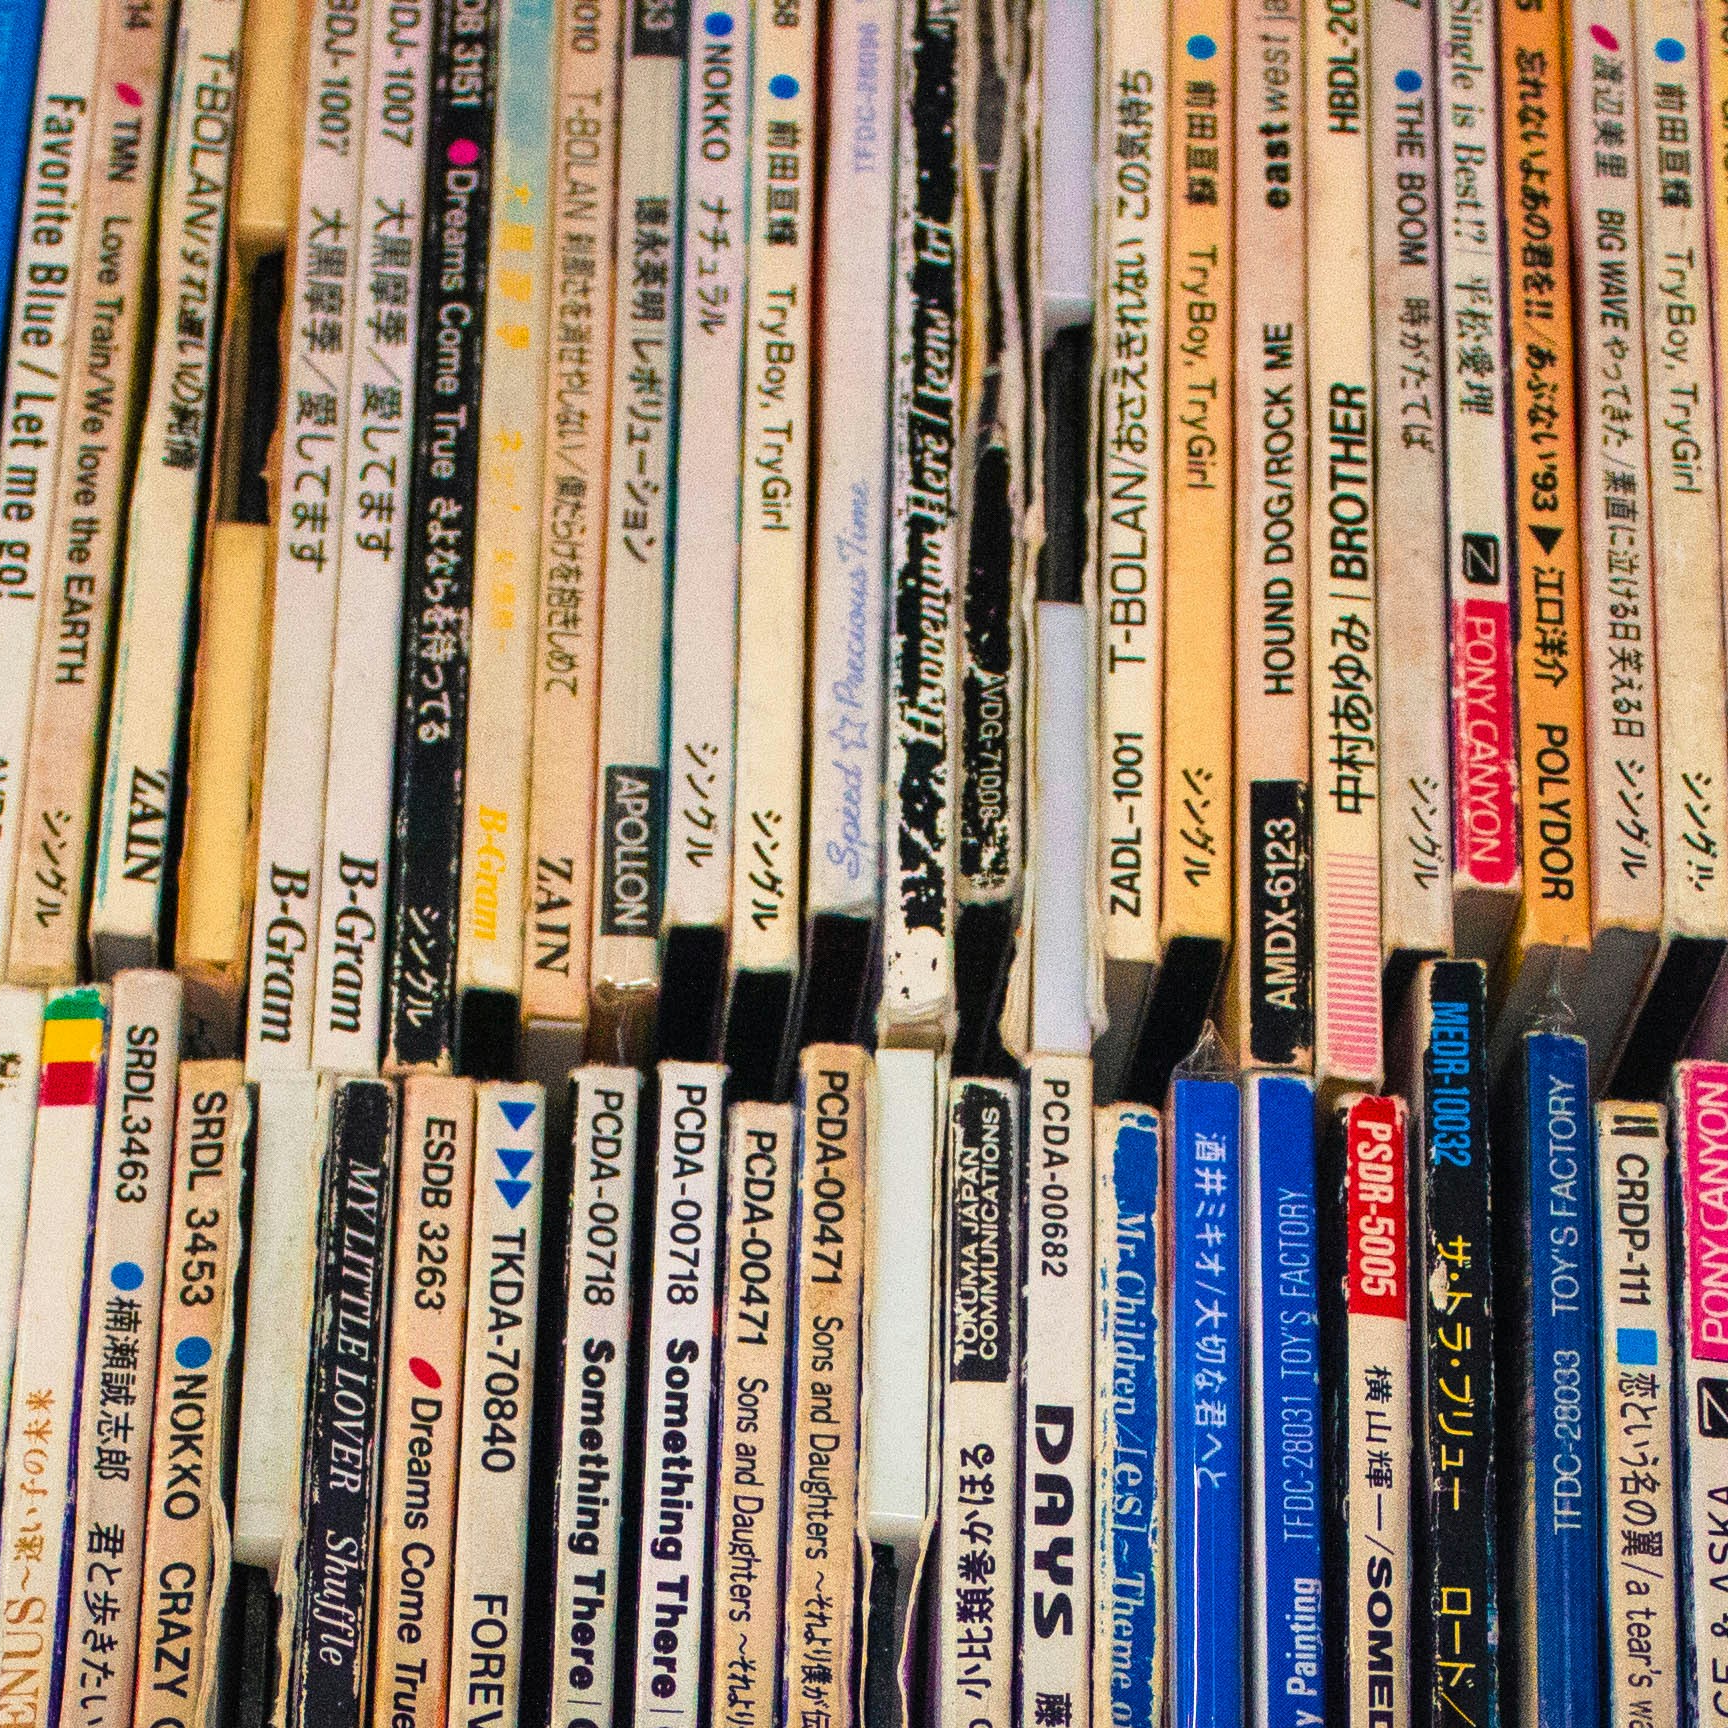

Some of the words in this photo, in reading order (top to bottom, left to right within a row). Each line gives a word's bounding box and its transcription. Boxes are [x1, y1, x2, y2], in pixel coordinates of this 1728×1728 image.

[697, 43, 734, 162] NOKKO
[1322, 381, 1370, 582] BROTHER
[1263, 572, 1295, 697] HOUND
[1466, 617, 1503, 714] PONY
[123, 767, 168, 882] ZAIN
[609, 775, 652, 927] APOLLON
[685, 742, 722, 870] シングル
[1109, 732, 1146, 917] ZADL-1001
[1463, 718, 1504, 863] CANYON
[1534, 722, 1575, 902] POLYDOR
[1259, 819, 1298, 1011] AMDX-6123
[190, 1091, 228, 1193] SRDL
[1432, 1001, 1471, 1168] MEDR-10032
[180, 1207, 218, 1307] 3453
[584, 1087, 624, 1307] PCDA-00718
[667, 1084, 707, 1307] PCDA-00718
[738, 1128, 778, 1345] PCDA-00471
[814, 1070, 850, 1284] PCDA-00471
[1034, 1079, 1070, 1279] PCDA-00682
[1356, 1121, 1397, 1298] PSDR-5005
[1616, 1154, 1652, 1307] CRDP-111
[481, 1228, 526, 1474] TKDA-70840
[167, 1374, 204, 1520] NOKKO
[651, 1339, 700, 1562] Something
[1034, 1404, 1074, 1640] DAYS
[1550, 1347, 1582, 1536] TFDC-28033
[77, 1521, 126, 1728] 君と歩きたい
[151, 1560, 195, 1699] CRAZY
